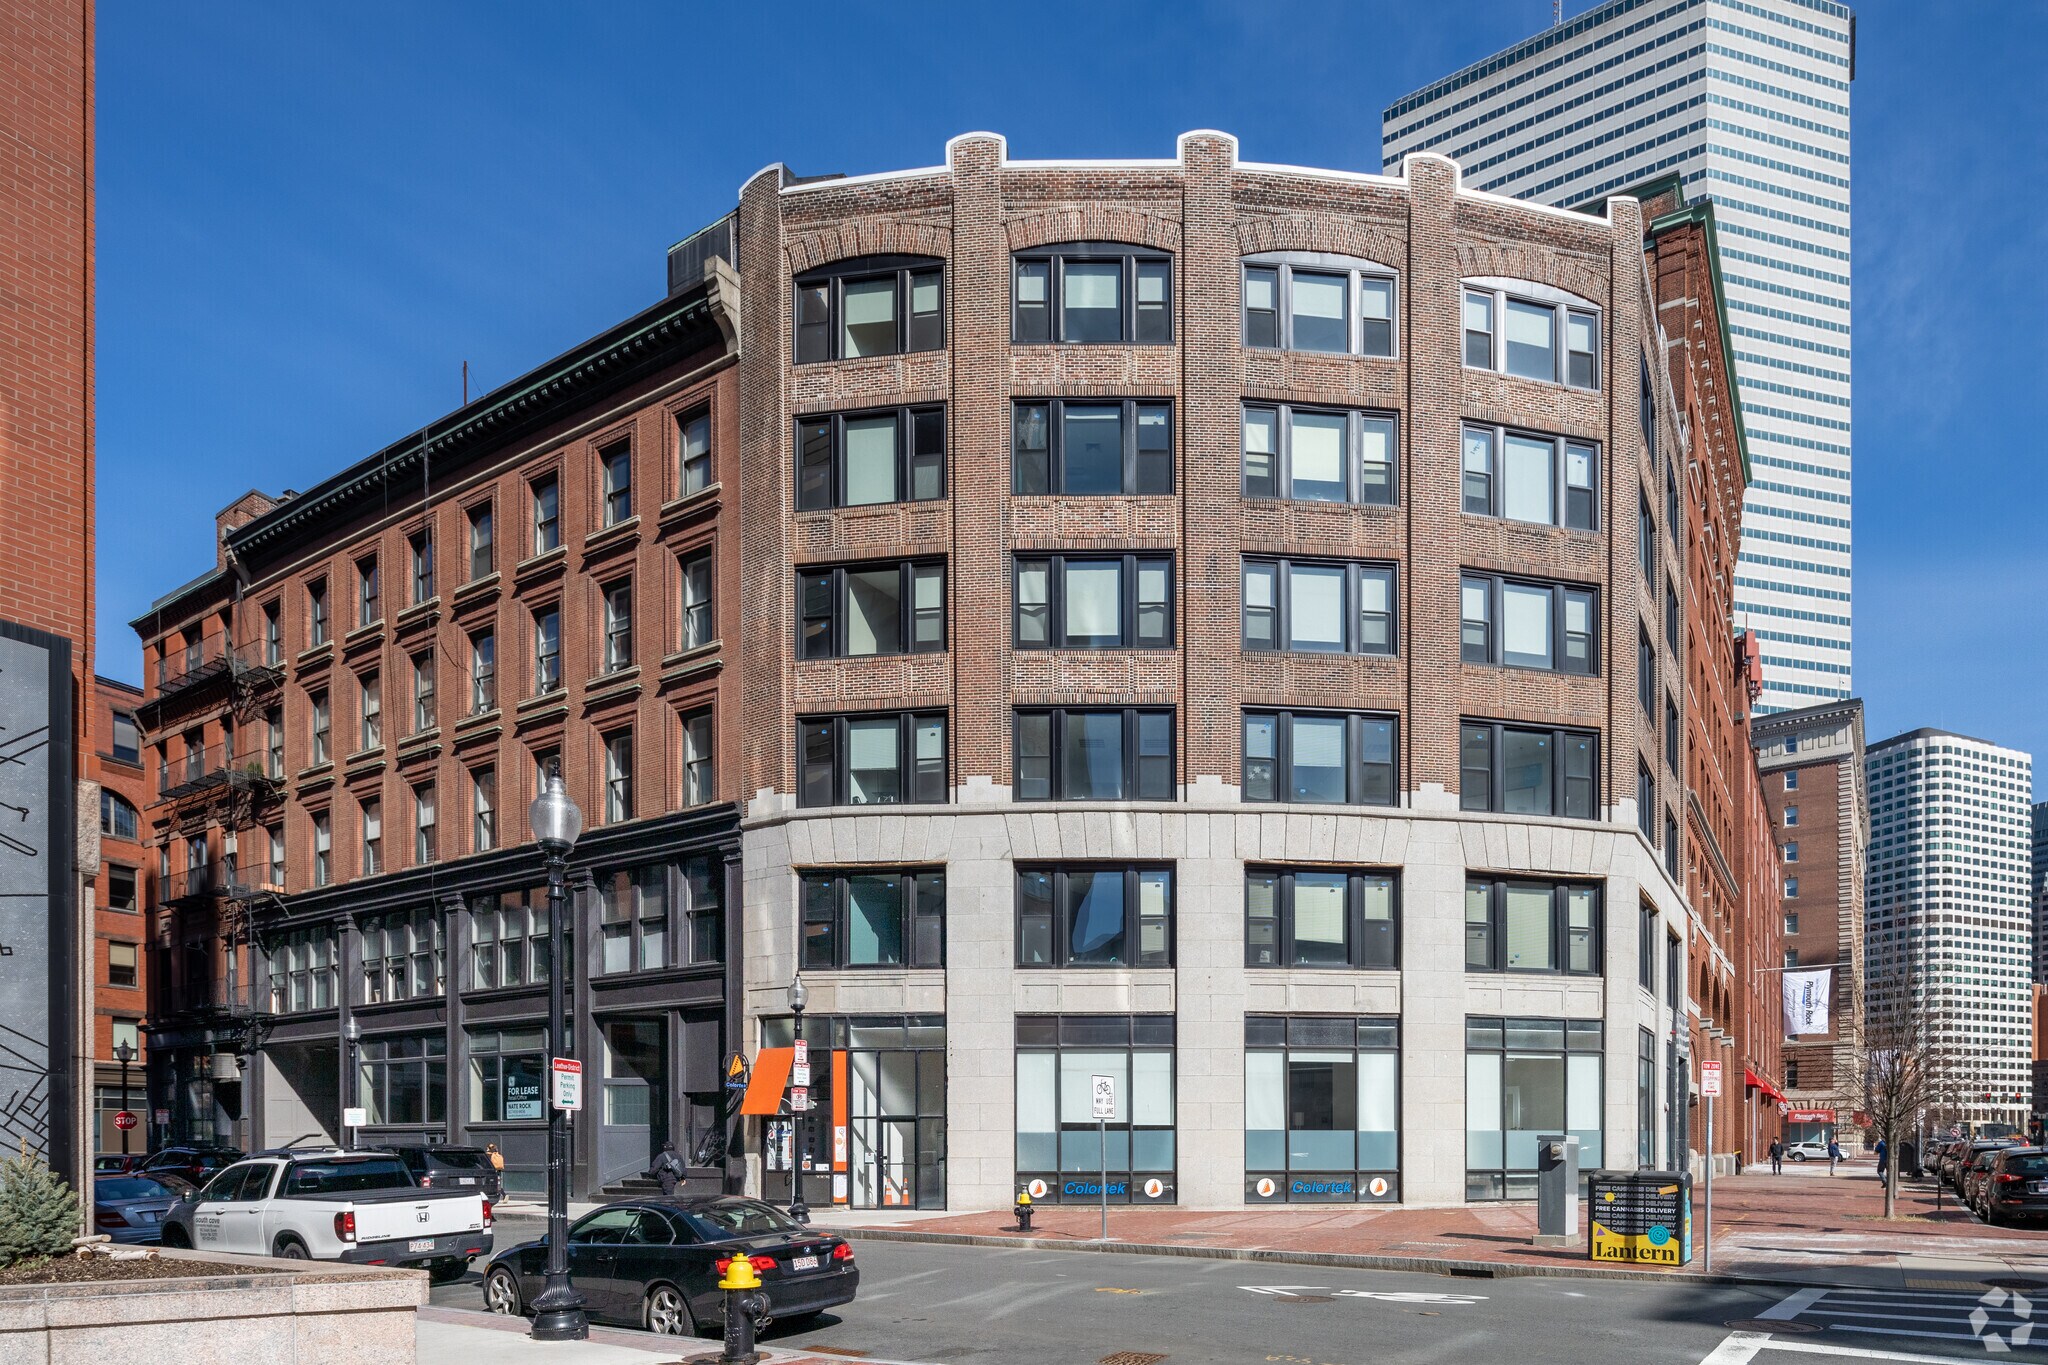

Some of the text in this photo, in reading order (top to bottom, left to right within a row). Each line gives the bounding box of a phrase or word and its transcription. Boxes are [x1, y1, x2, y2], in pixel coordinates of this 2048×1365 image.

[1806, 981, 1814, 1008] Plymouth
[520, 1086, 538, 1094] LEASE
[560, 1081, 576, 1090] Parking
[563, 1090, 572, 1098] Only
[115, 1116, 136, 1124] STOP
[1064, 1181, 1126, 1195] Colortek
[1292, 1181, 1351, 1194] Colortek
[1596, 1242, 1675, 1261] Lantern
